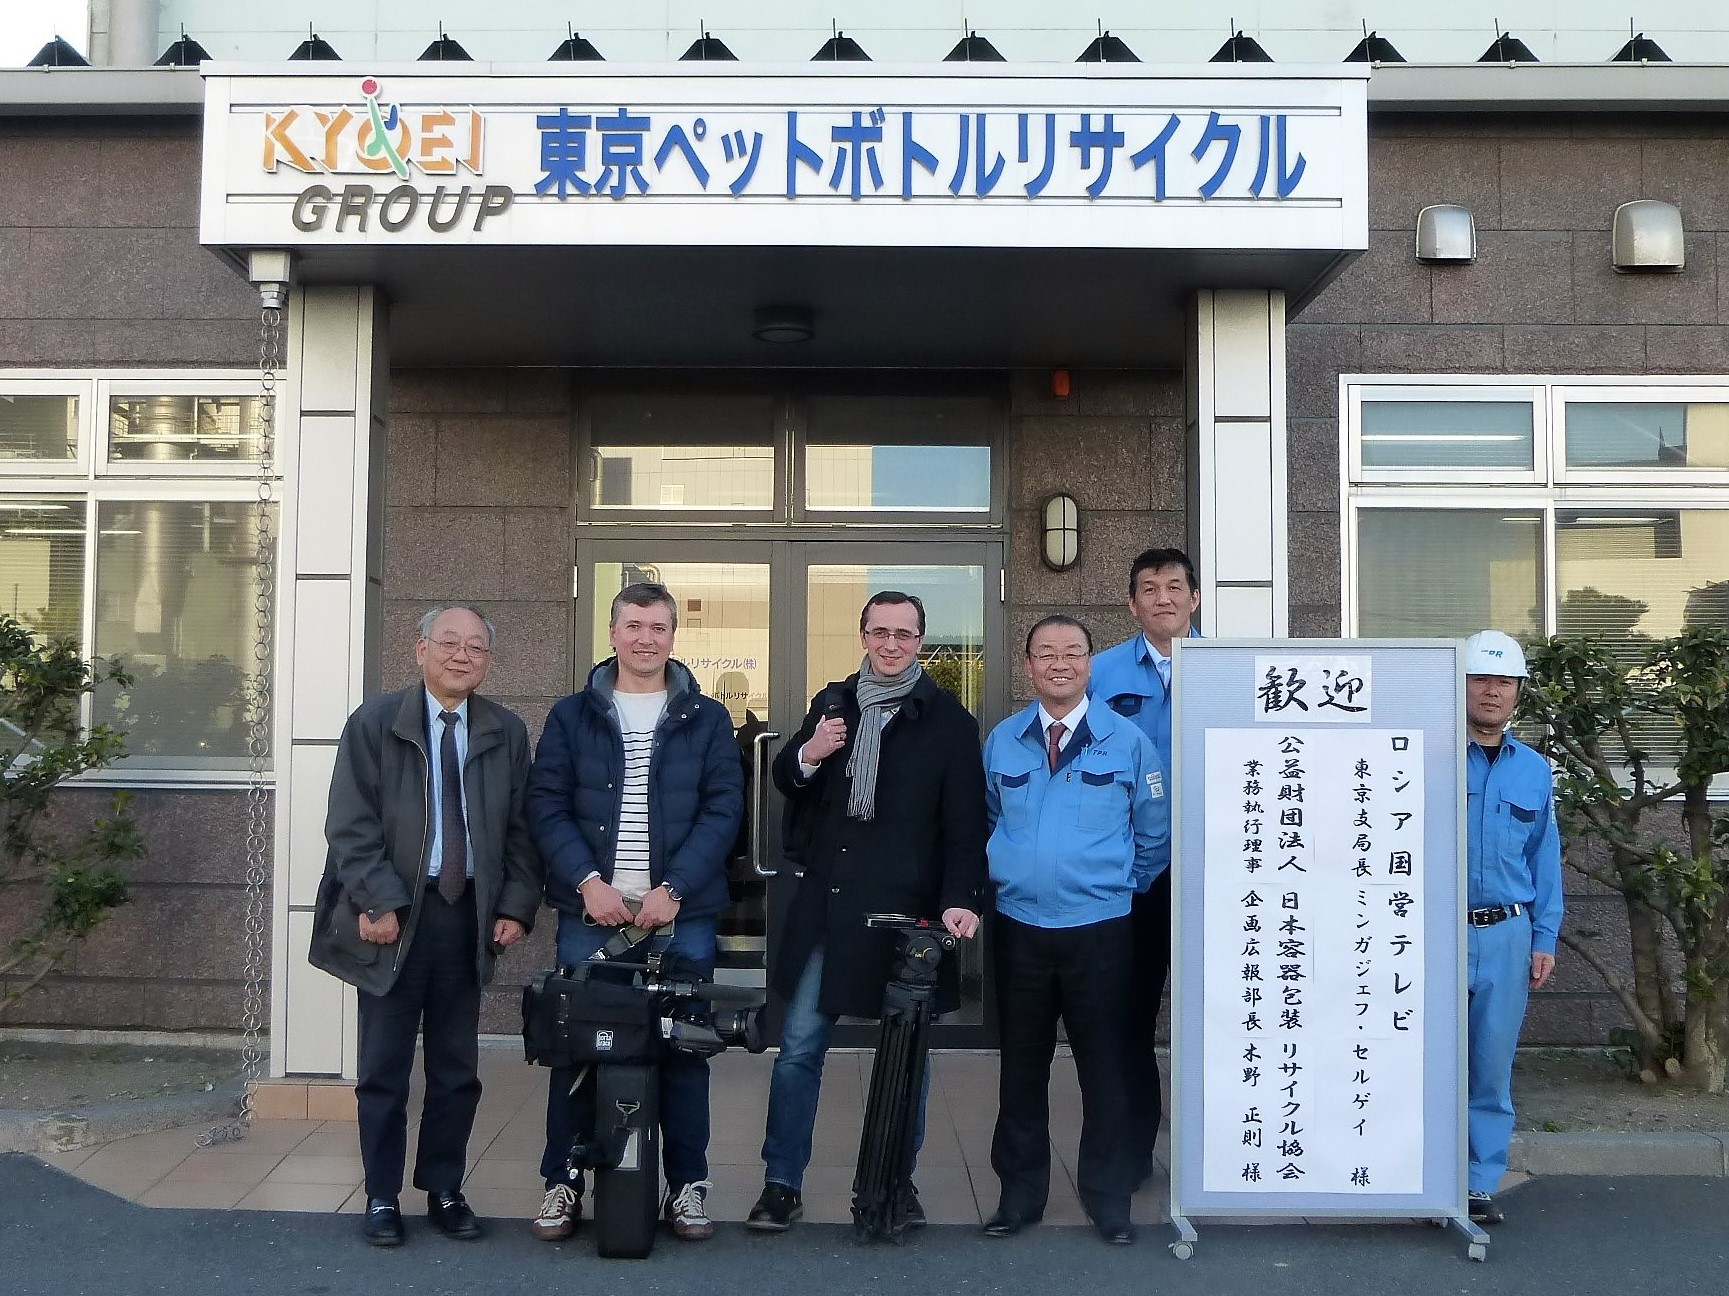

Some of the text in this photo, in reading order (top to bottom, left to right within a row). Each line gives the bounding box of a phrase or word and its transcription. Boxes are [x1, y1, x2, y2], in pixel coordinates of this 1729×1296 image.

[263, 104, 485, 176] KYOEI
[535, 107, 1306, 200] 東京ペットボトルリサイクル
[291, 184, 514, 233] GROUP
[1256, 665, 1368, 714] 歓迎
[1388, 736, 1414, 1031] ロシア国営テレビ
